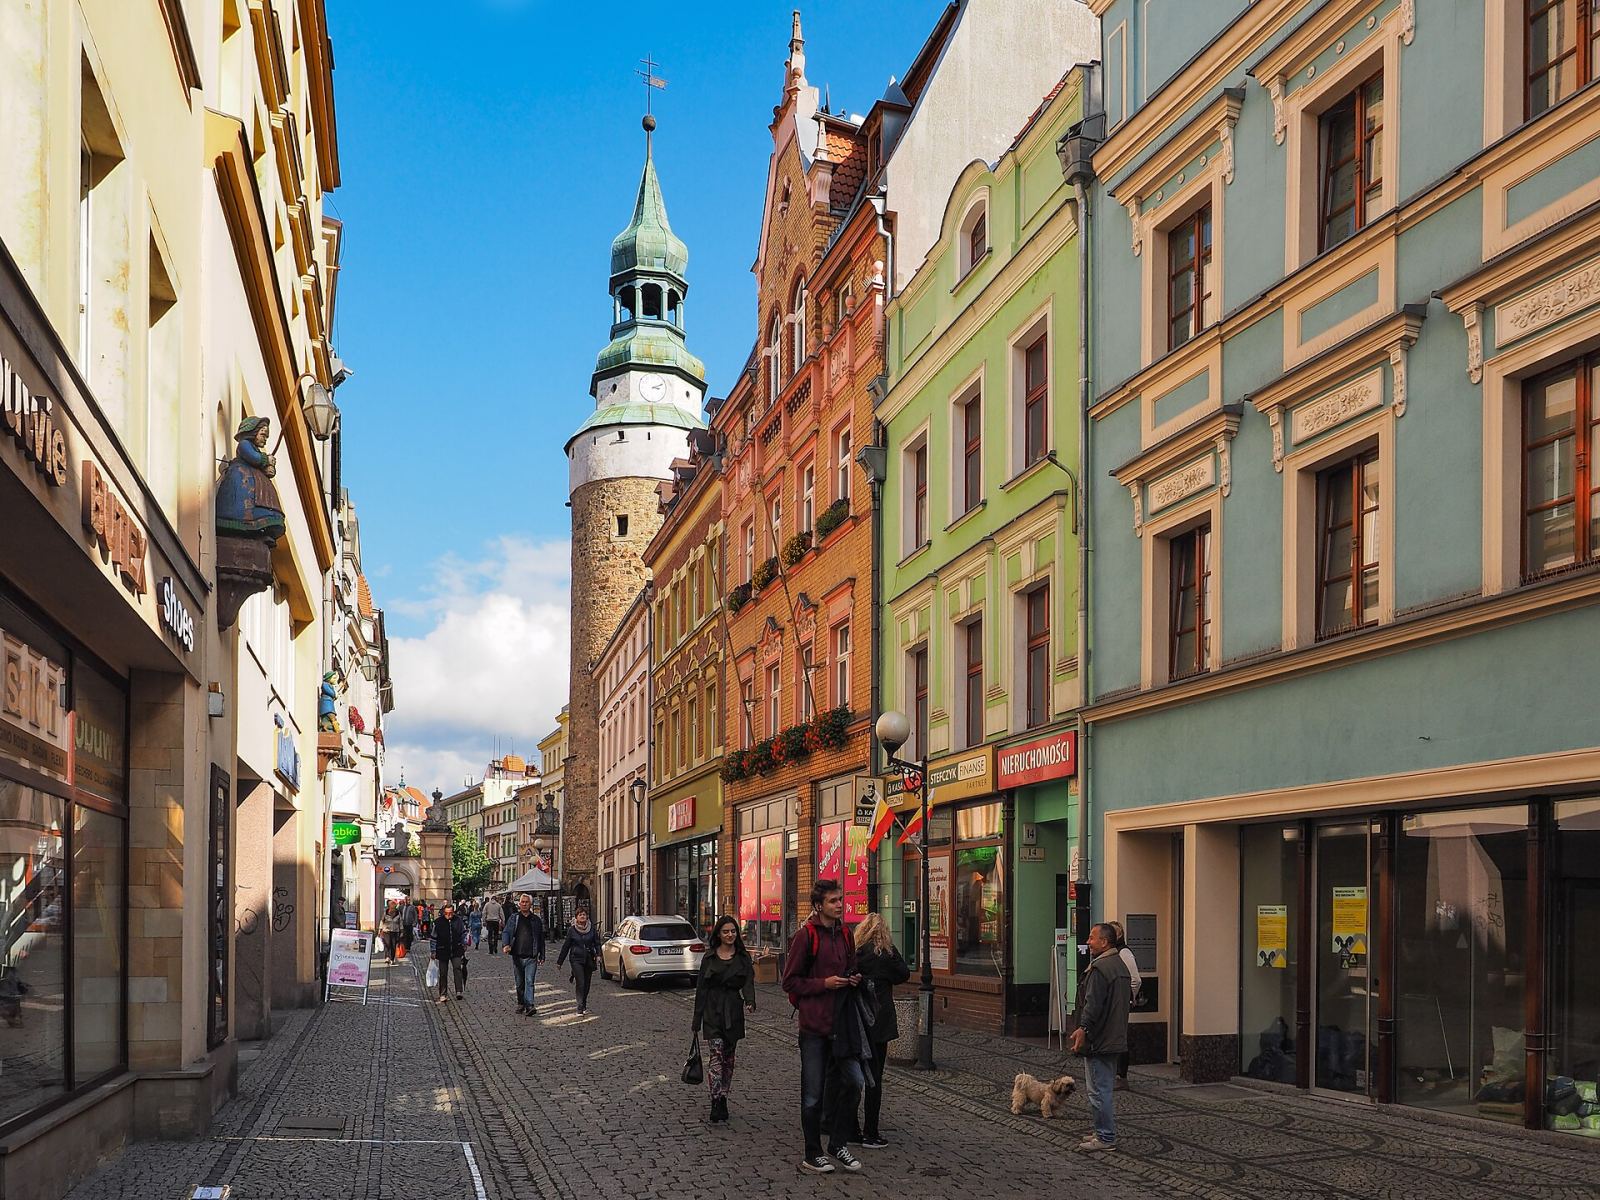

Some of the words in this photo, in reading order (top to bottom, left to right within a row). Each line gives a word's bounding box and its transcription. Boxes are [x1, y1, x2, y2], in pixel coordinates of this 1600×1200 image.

[0, 351, 66, 486] uwie
[163, 577, 194, 652] shoes
[1001, 739, 1070, 776] NIERUCHOMOŚCI
[930, 767, 957, 785] STEFCZYK
[959, 759, 984, 777] FINANSE
[966, 778, 987, 789] PARTNER
[333, 827, 358, 836] abka
[1027, 829, 1035, 839] 14
